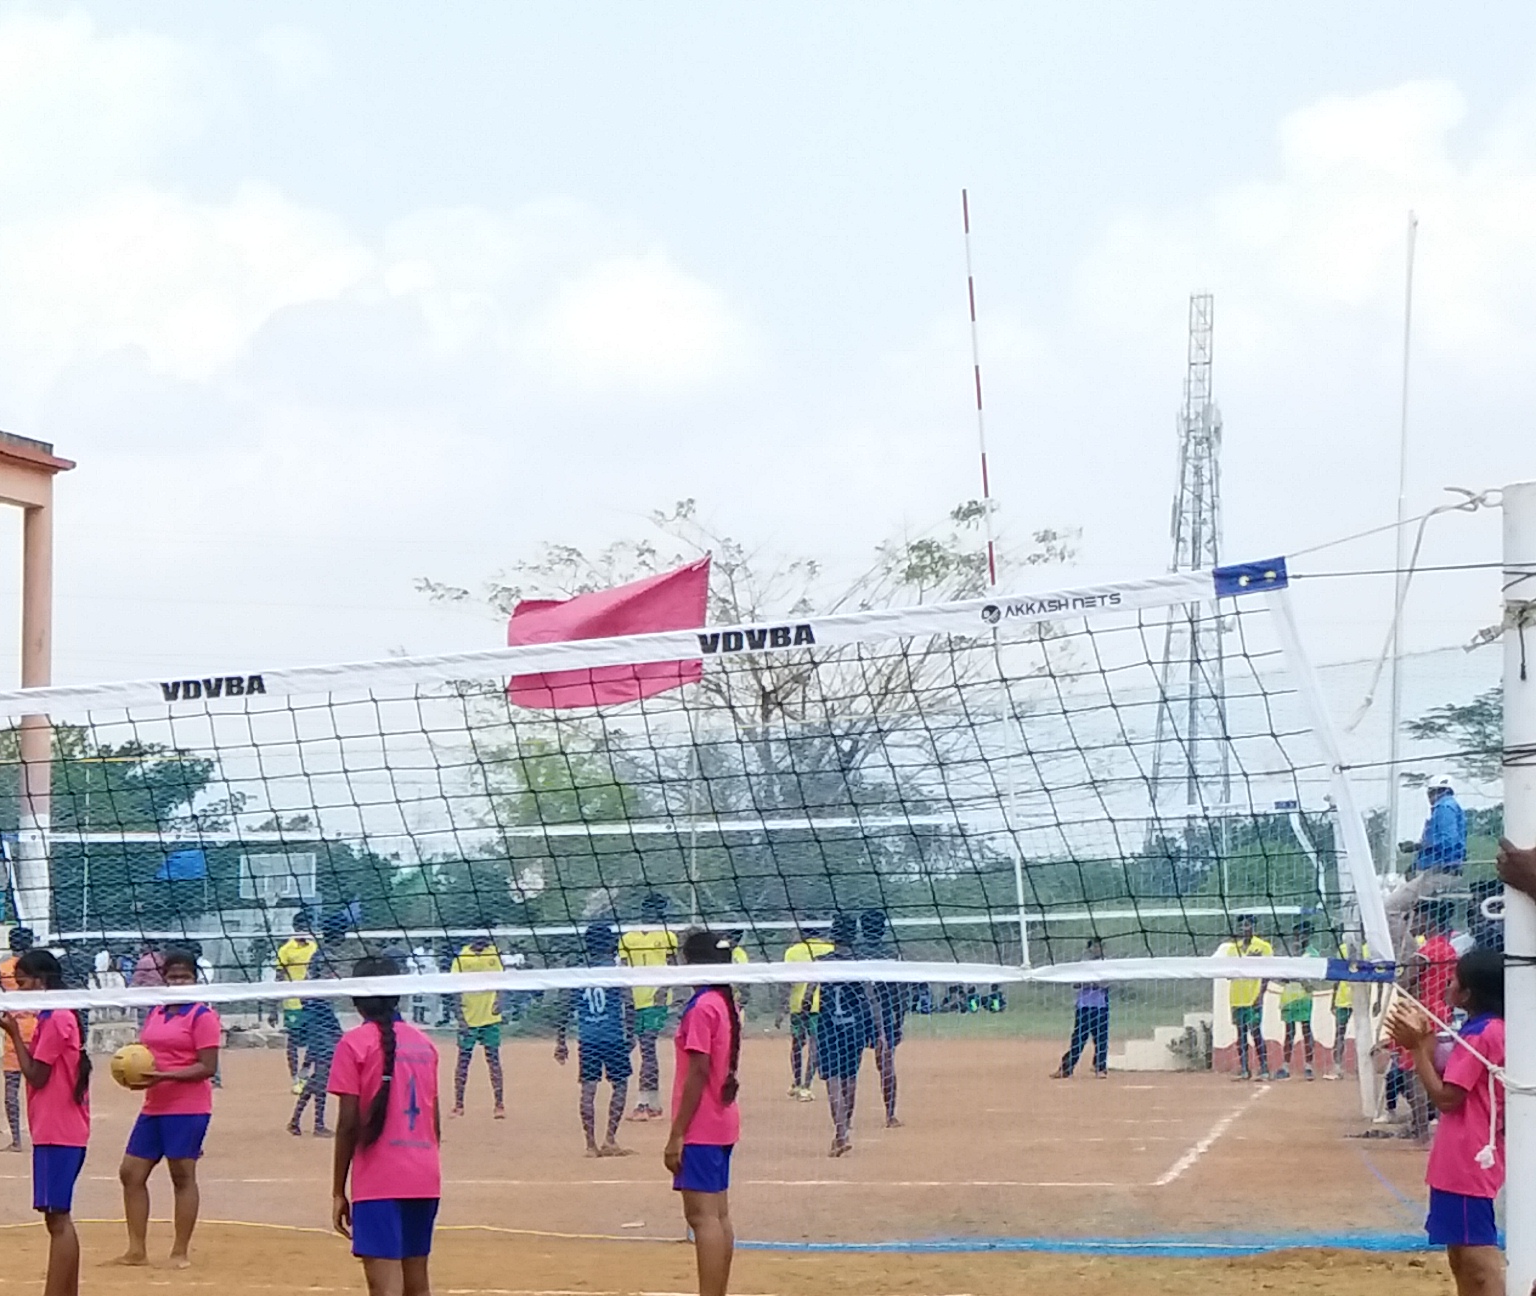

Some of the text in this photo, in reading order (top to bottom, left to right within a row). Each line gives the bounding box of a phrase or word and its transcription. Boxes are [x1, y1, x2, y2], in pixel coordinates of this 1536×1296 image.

[1005, 599, 1069, 618] AKKASH
[697, 623, 816, 654] VDVBA
[159, 674, 267, 702] VDVBA
[582, 987, 606, 1014] 10
